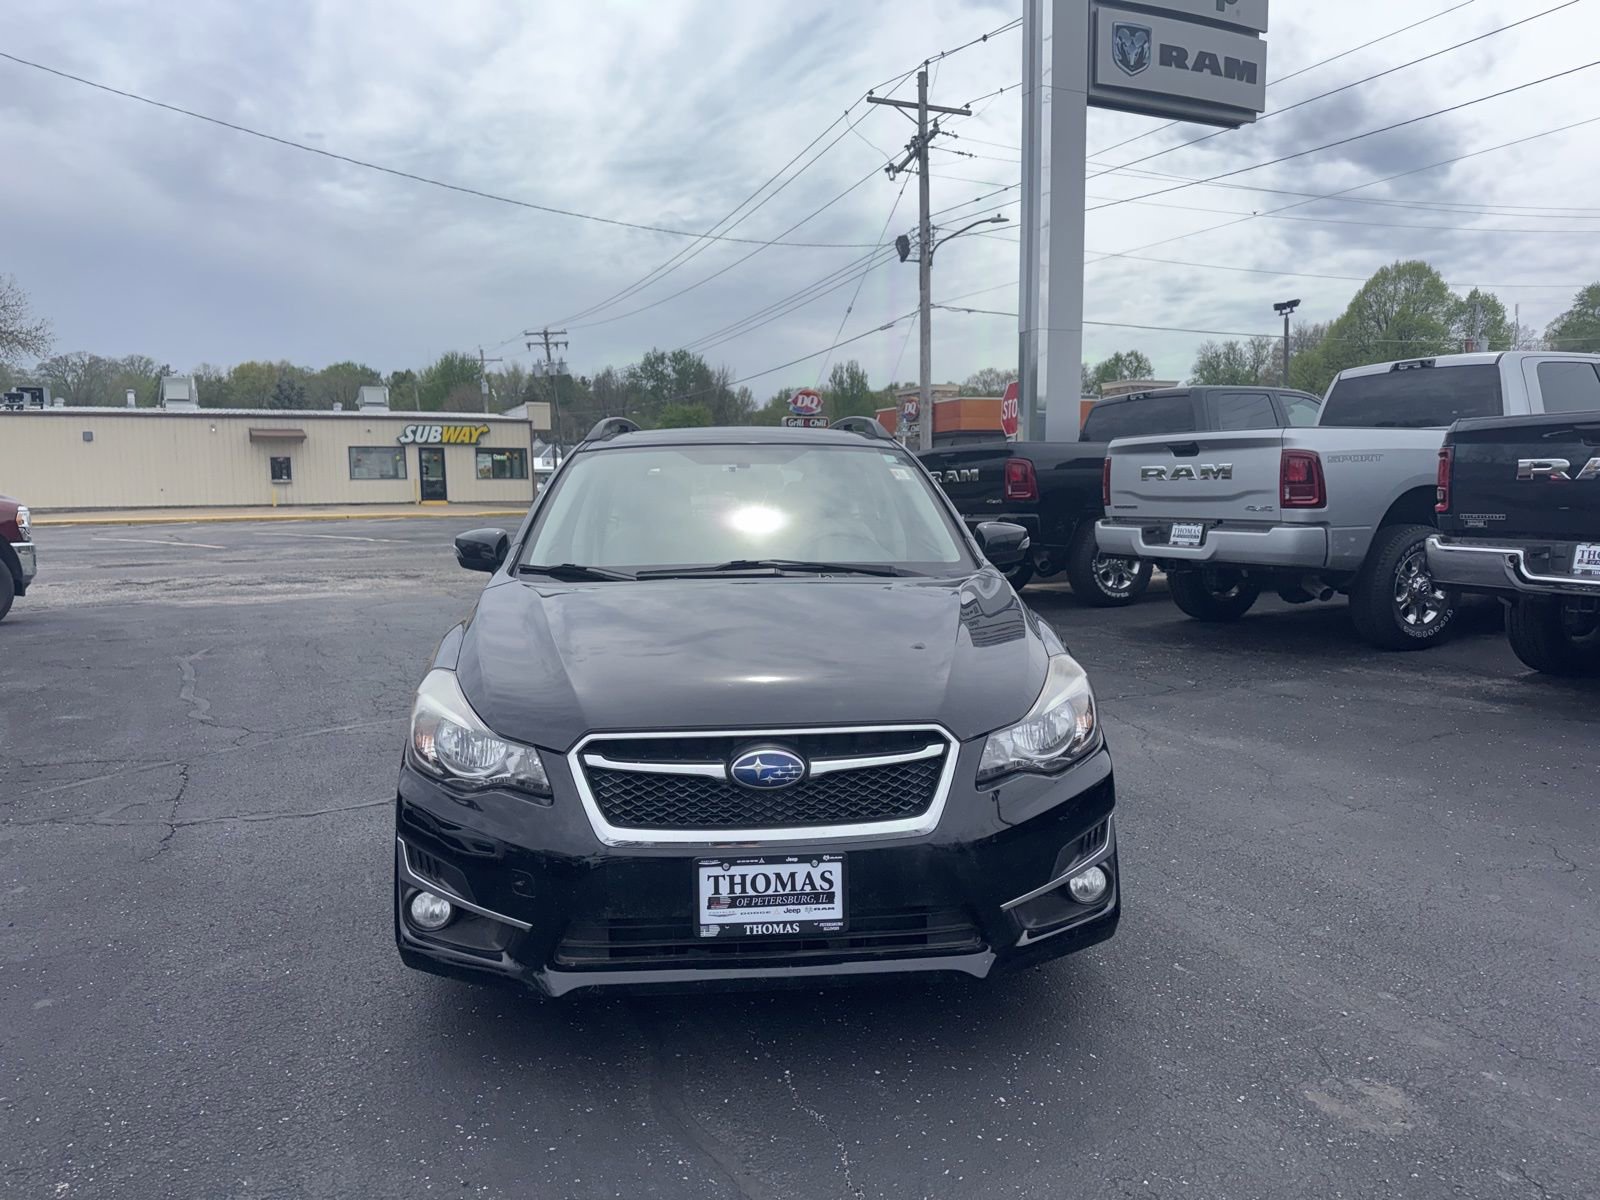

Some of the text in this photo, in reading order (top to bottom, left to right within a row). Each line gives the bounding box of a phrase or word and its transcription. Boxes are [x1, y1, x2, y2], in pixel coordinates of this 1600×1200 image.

[1159, 43, 1258, 84] RAM
[797, 394, 819, 408] DQ
[905, 402, 917, 414] DQ
[1003, 399, 1018, 420] STO
[788, 419, 804, 427] Grill
[810, 419, 827, 427] Chill
[399, 424, 490, 445] SUBWAY
[1141, 463, 1233, 482] RAM
[707, 870, 834, 896] THOMAS
[737, 894, 829, 907] OF PETERSBURG, IL
[784, 906, 802, 914] Jeep
[744, 922, 800, 935] THOMAS
